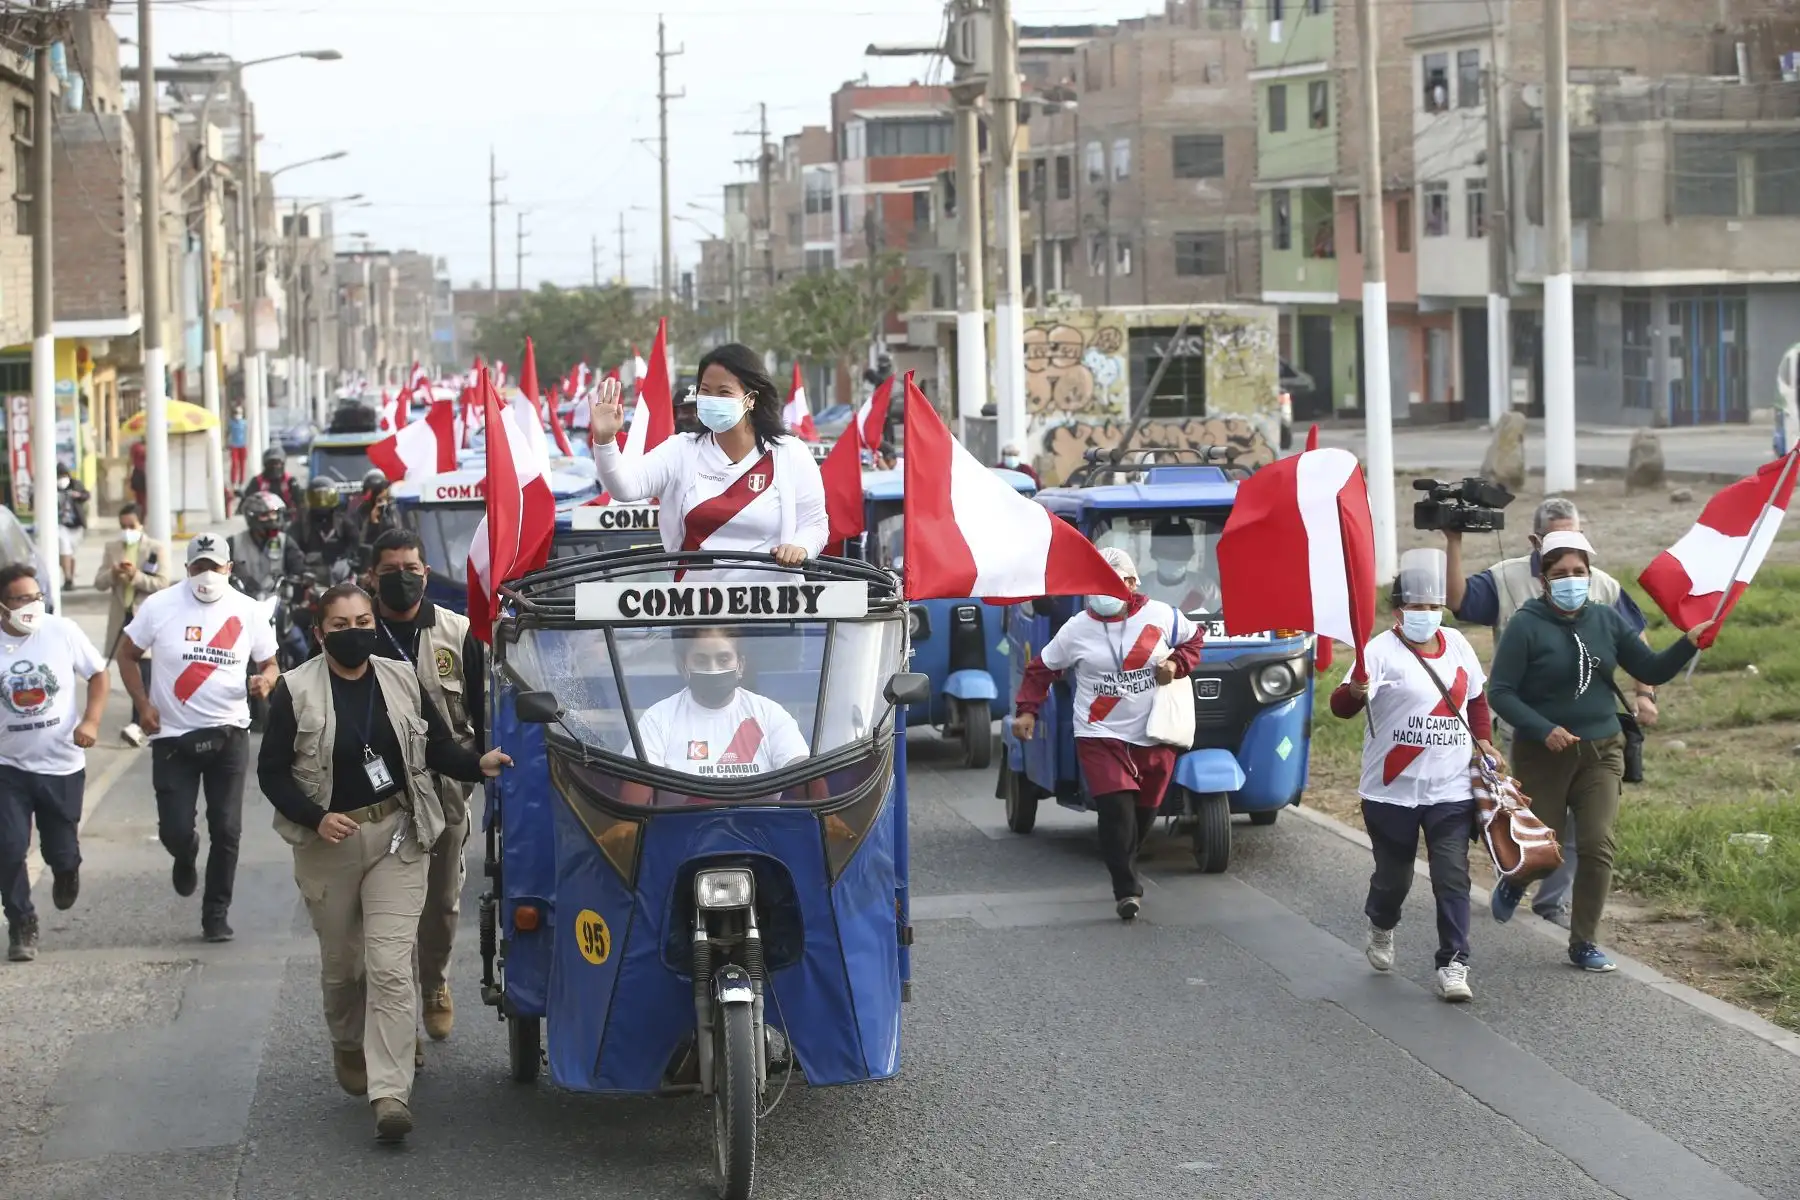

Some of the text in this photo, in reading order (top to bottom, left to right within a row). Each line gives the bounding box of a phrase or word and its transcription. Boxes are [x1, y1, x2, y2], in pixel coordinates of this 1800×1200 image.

[618, 585, 825, 618] COMDERBY
[208, 656, 241, 665] ADELAN
[1117, 669, 1151, 683] CAMBIO
[1094, 684, 1118, 696] HACIA
[1201, 685, 1216, 694] RE
[1408, 716, 1423, 729] UN
[1393, 730, 1422, 744] HACIA
[690, 742, 705, 757] K
[699, 764, 759, 773] UN CAMBIO
[583, 920, 605, 957] 95
